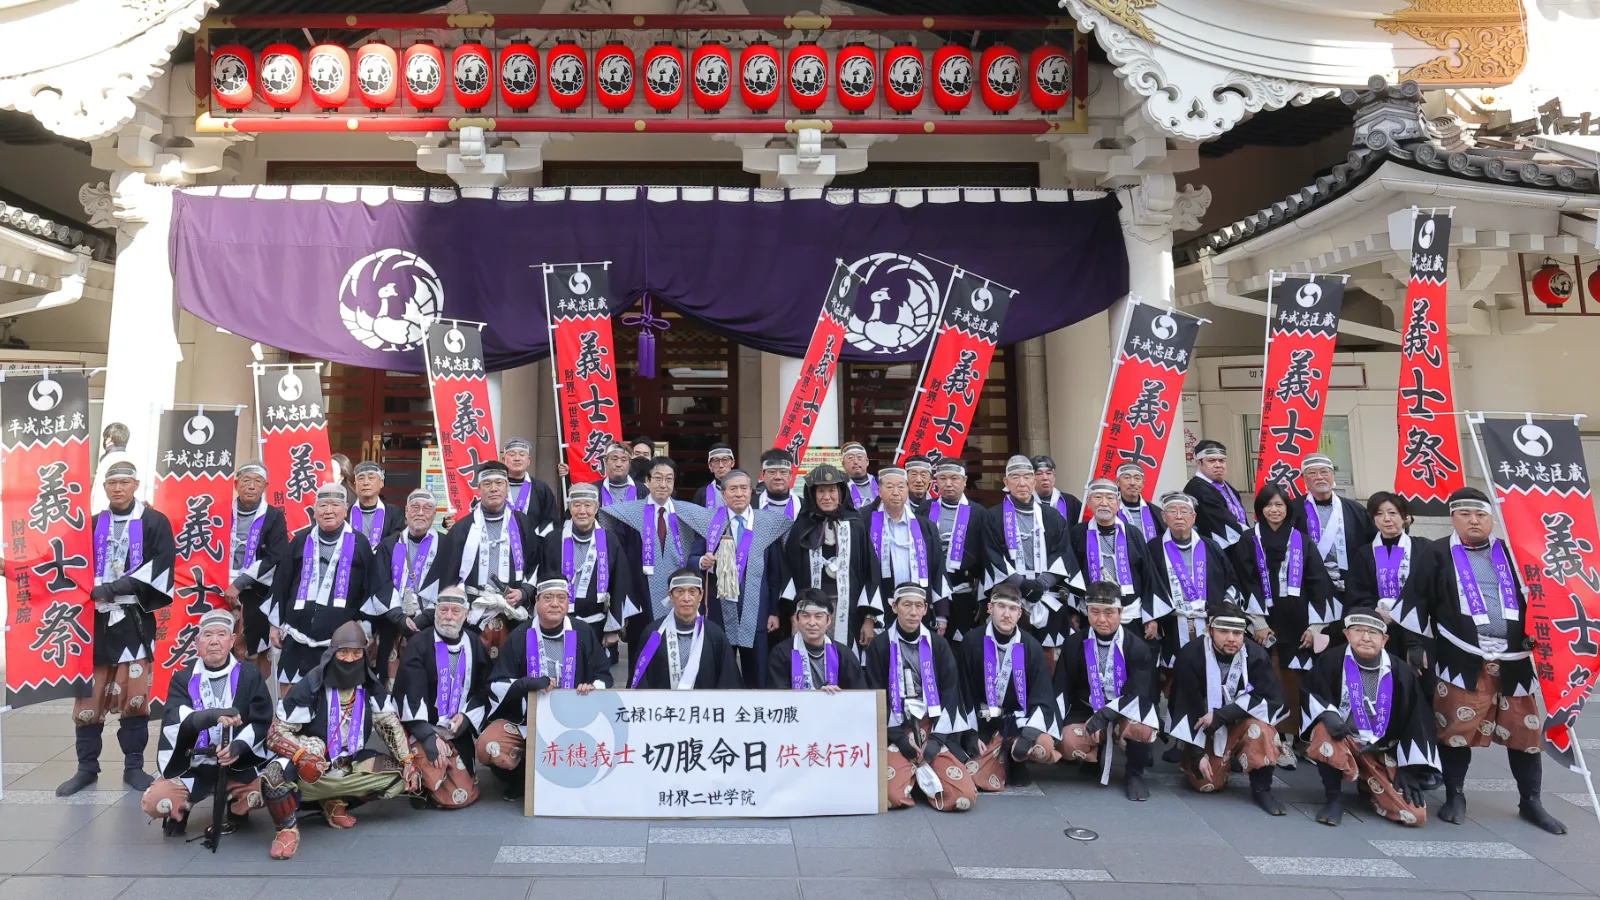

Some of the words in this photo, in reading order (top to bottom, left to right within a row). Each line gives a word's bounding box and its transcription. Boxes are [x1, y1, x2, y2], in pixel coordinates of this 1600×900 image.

[557, 297, 608, 312] 平成忠臣蔵
[1278, 310, 1336, 328] 平成忠臣蔵
[951, 307, 998, 336] 平成忠臣蔵
[434, 356, 483, 372] 平成忠臣蔵
[1130, 335, 1187, 364] 平成忠臣蔵
[564, 369, 581, 443] 財界二世学院
[781, 363, 814, 437] 財界二世学院
[1401, 298, 1458, 487] 義士祭
[8, 411, 86, 438] 平成忠臣蔵
[266, 404, 323, 423] 平成忠臣蔵
[909, 378, 942, 456] 財界二世学院
[162, 447, 232, 469] 平成忠臣蔵
[1498, 460, 1586, 484] 平成忠臣蔵
[11, 520, 31, 624] 財界二世学院
[28, 461, 91, 667] 義士祭
[1496, 564, 1513, 595] 切腹命日
[1523, 564, 1554, 681] 財界二世学院
[923, 661, 934, 692] 切腹命日
[1350, 682, 1365, 715] 切腹命日
[614, 705, 725, 724] 元禄16年2月4日
[735, 705, 800, 724] 全員切腹
[541, 741, 636, 769] 赤穂義士
[642, 736, 767, 774] 切腹命日
[775, 742, 871, 769] 供養行列
[658, 789, 756, 806] 財界二世学院
